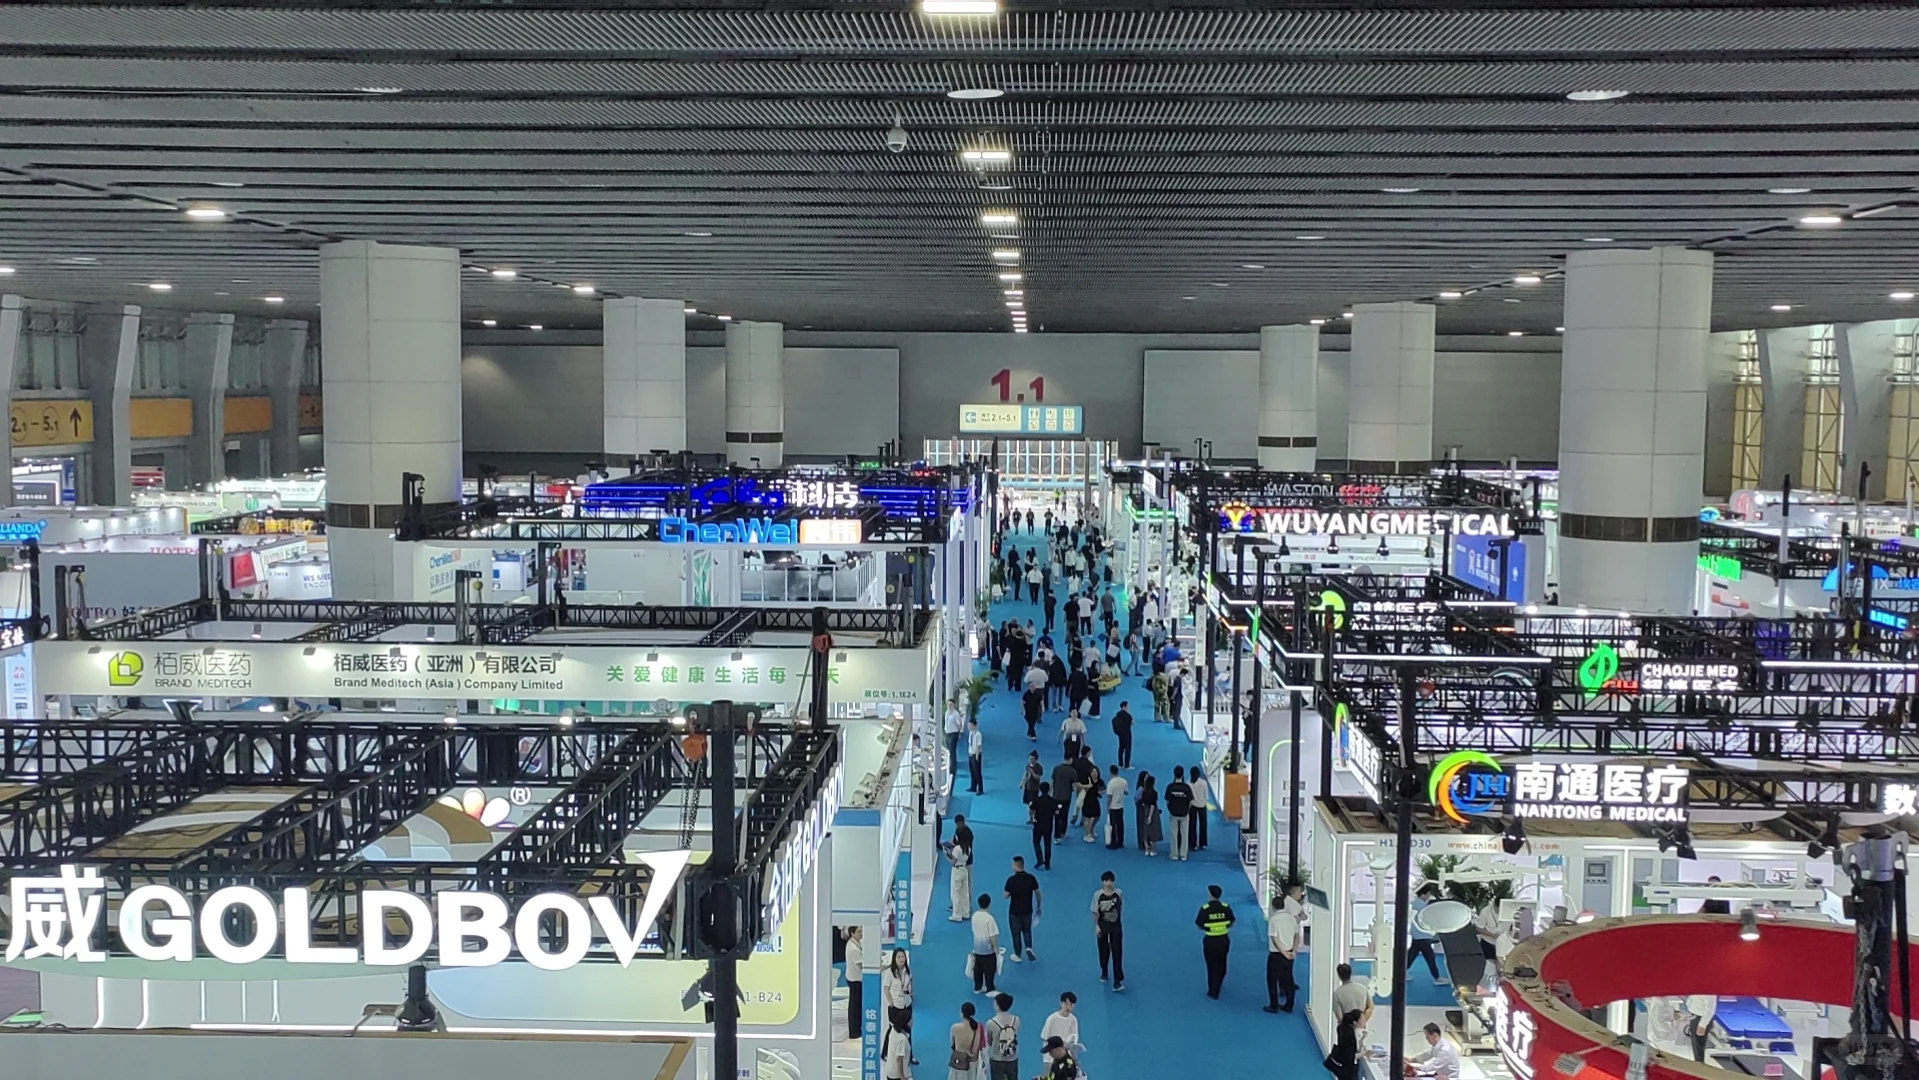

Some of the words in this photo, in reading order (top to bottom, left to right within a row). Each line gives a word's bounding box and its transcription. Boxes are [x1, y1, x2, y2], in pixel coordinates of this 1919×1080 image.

[991, 369, 1044, 402] 1.1
[660, 517, 798, 544] ChenWei
[1642, 664, 1704, 678] CHAOJIE
[1706, 665, 1739, 678] MED
[155, 678, 192, 688] BRAND
[197, 678, 252, 688] MEDITECH
[334, 677, 368, 688] Brand
[371, 677, 422, 689] Meditech
[464, 678, 517, 691] Company
[521, 679, 563, 690] Limited
[1514, 762, 1689, 804] 南通医疗
[1514, 804, 1603, 820] NANTONG
[1609, 805, 1687, 822] MEDICAL
[119, 850, 692, 970] GOLDBOV
